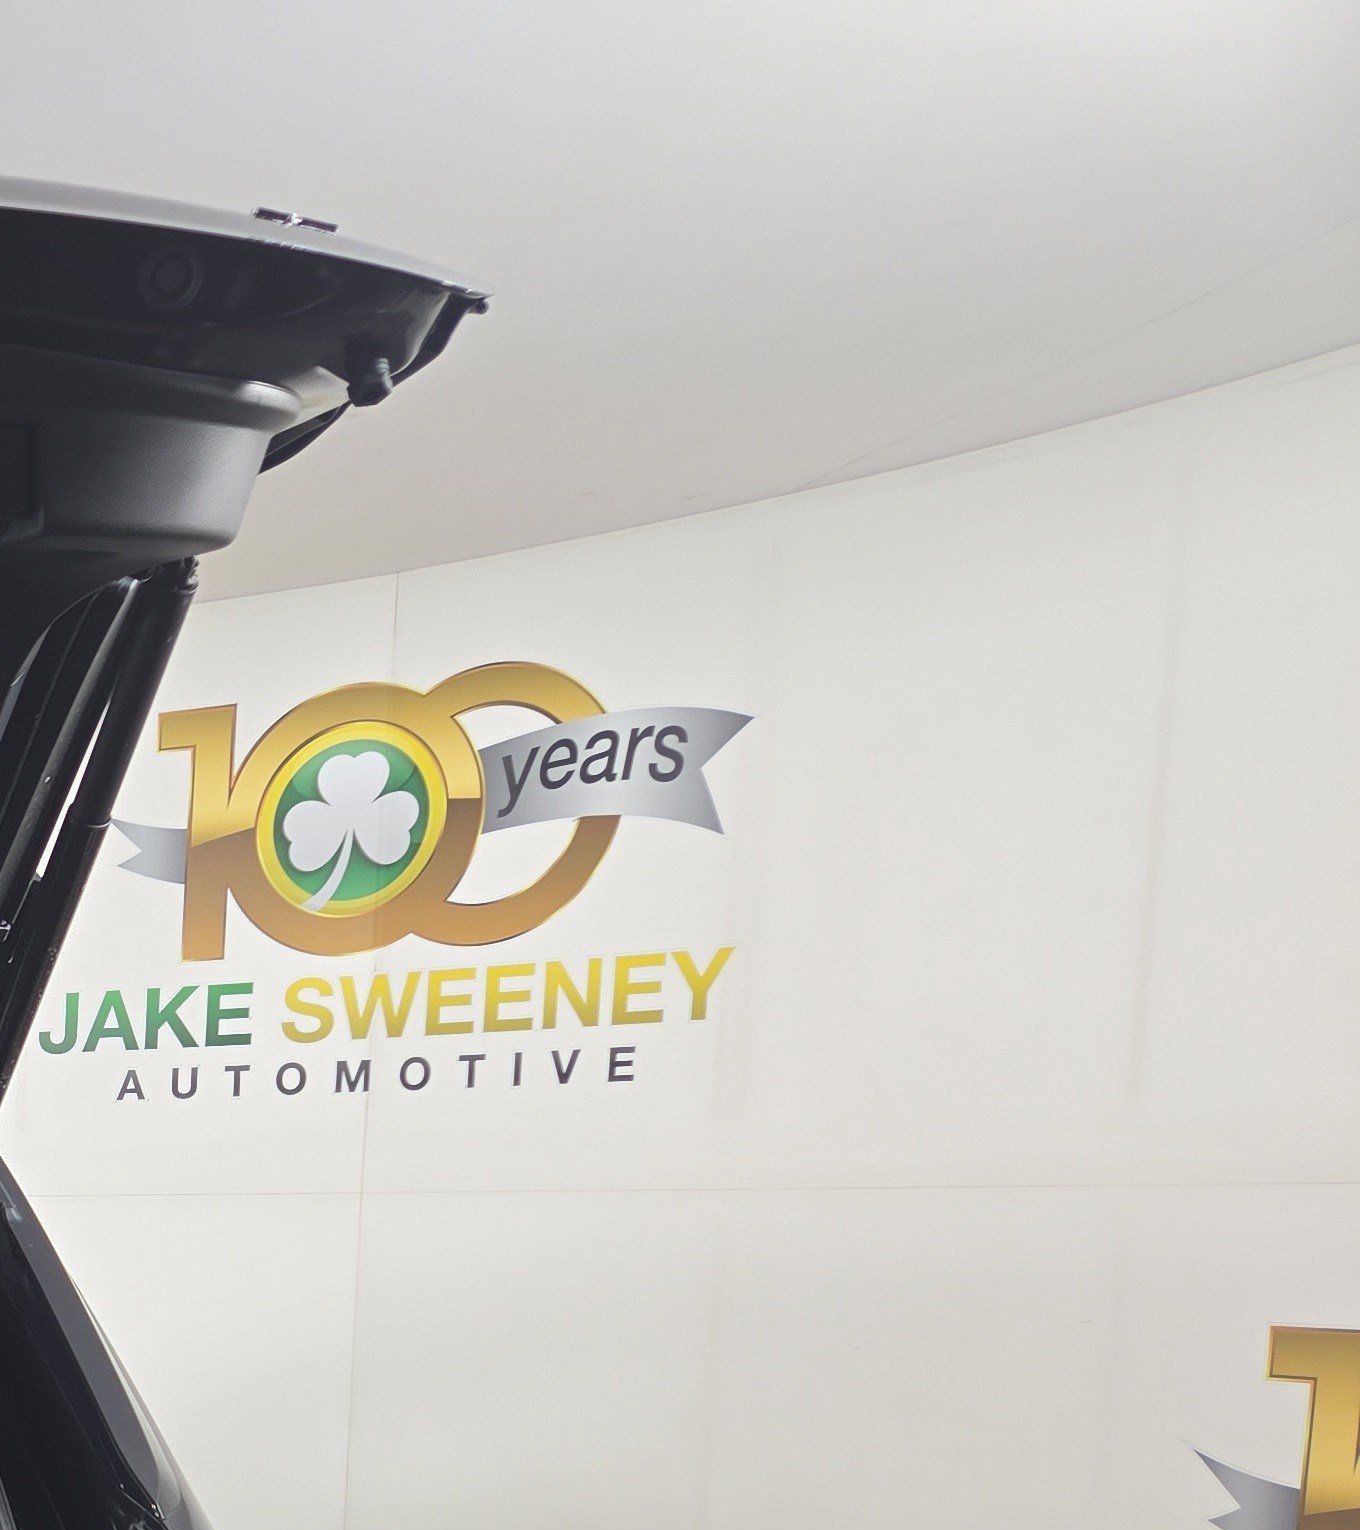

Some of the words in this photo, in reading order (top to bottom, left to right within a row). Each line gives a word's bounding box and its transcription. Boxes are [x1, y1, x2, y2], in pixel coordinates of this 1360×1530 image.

[157, 661, 621, 963] 100
[496, 724, 689, 817] years
[39, 982, 254, 1056] JAKE
[281, 947, 736, 1044] SWEENEY
[116, 1046, 639, 1102] AUTOMOTIVE
